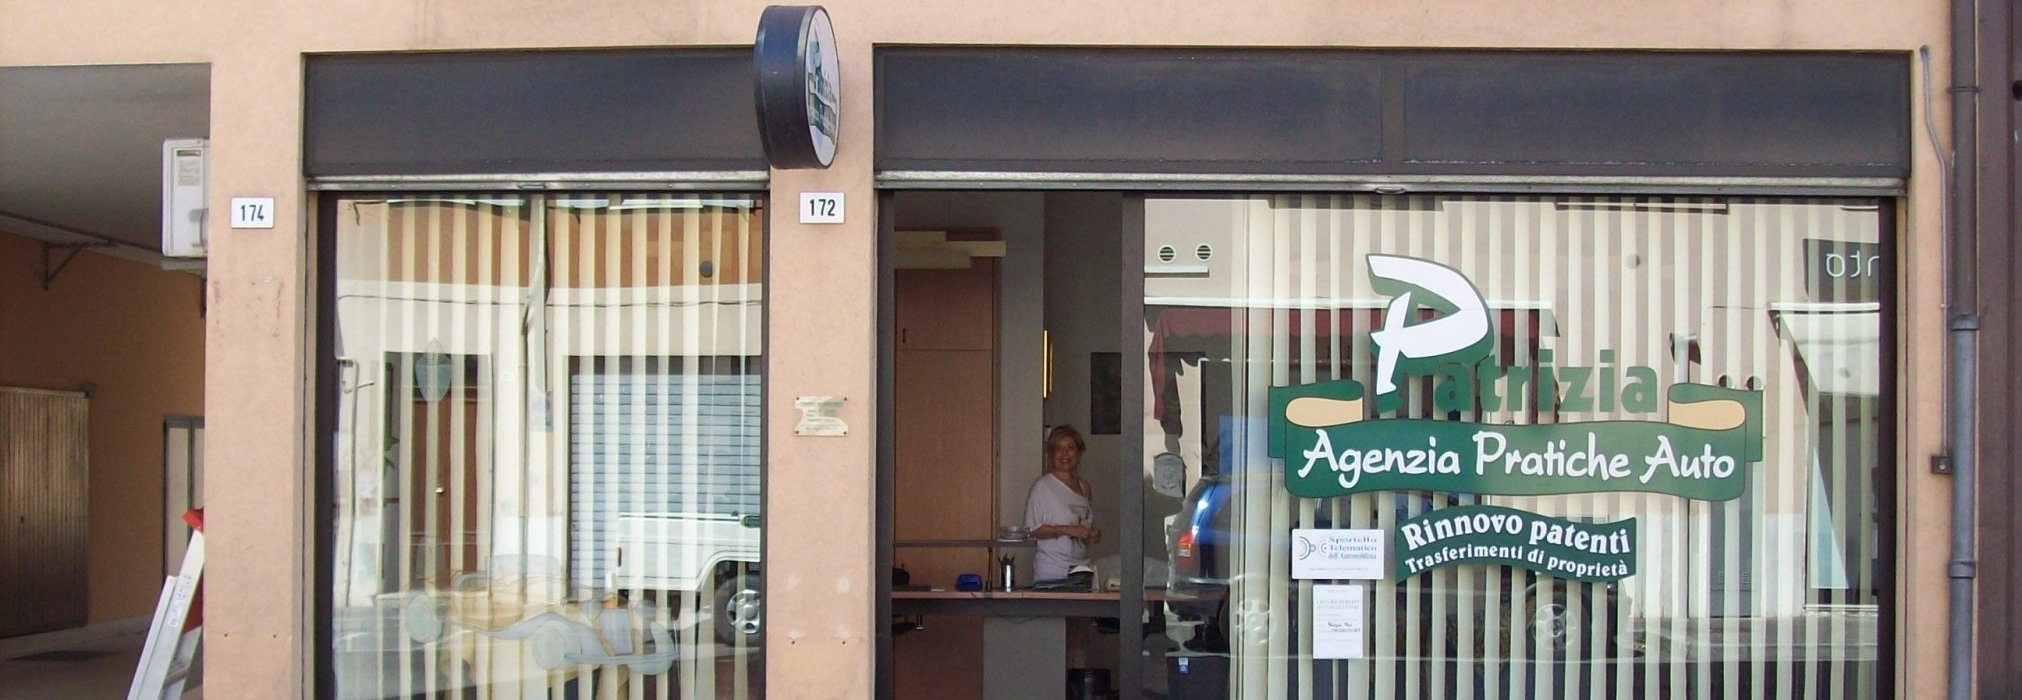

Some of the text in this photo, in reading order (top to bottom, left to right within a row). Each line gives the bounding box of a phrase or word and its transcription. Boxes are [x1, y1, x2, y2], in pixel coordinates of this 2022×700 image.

[240, 204, 265, 222] 174
[809, 199, 836, 217] 172
[1366, 253, 1658, 414] Patrizia
[1297, 429, 1735, 489] Agenzia Pratiche Auto
[1401, 513, 1631, 554] Rinnovo patenti
[1405, 543, 1628, 578] Trasferimenti di proprietà
